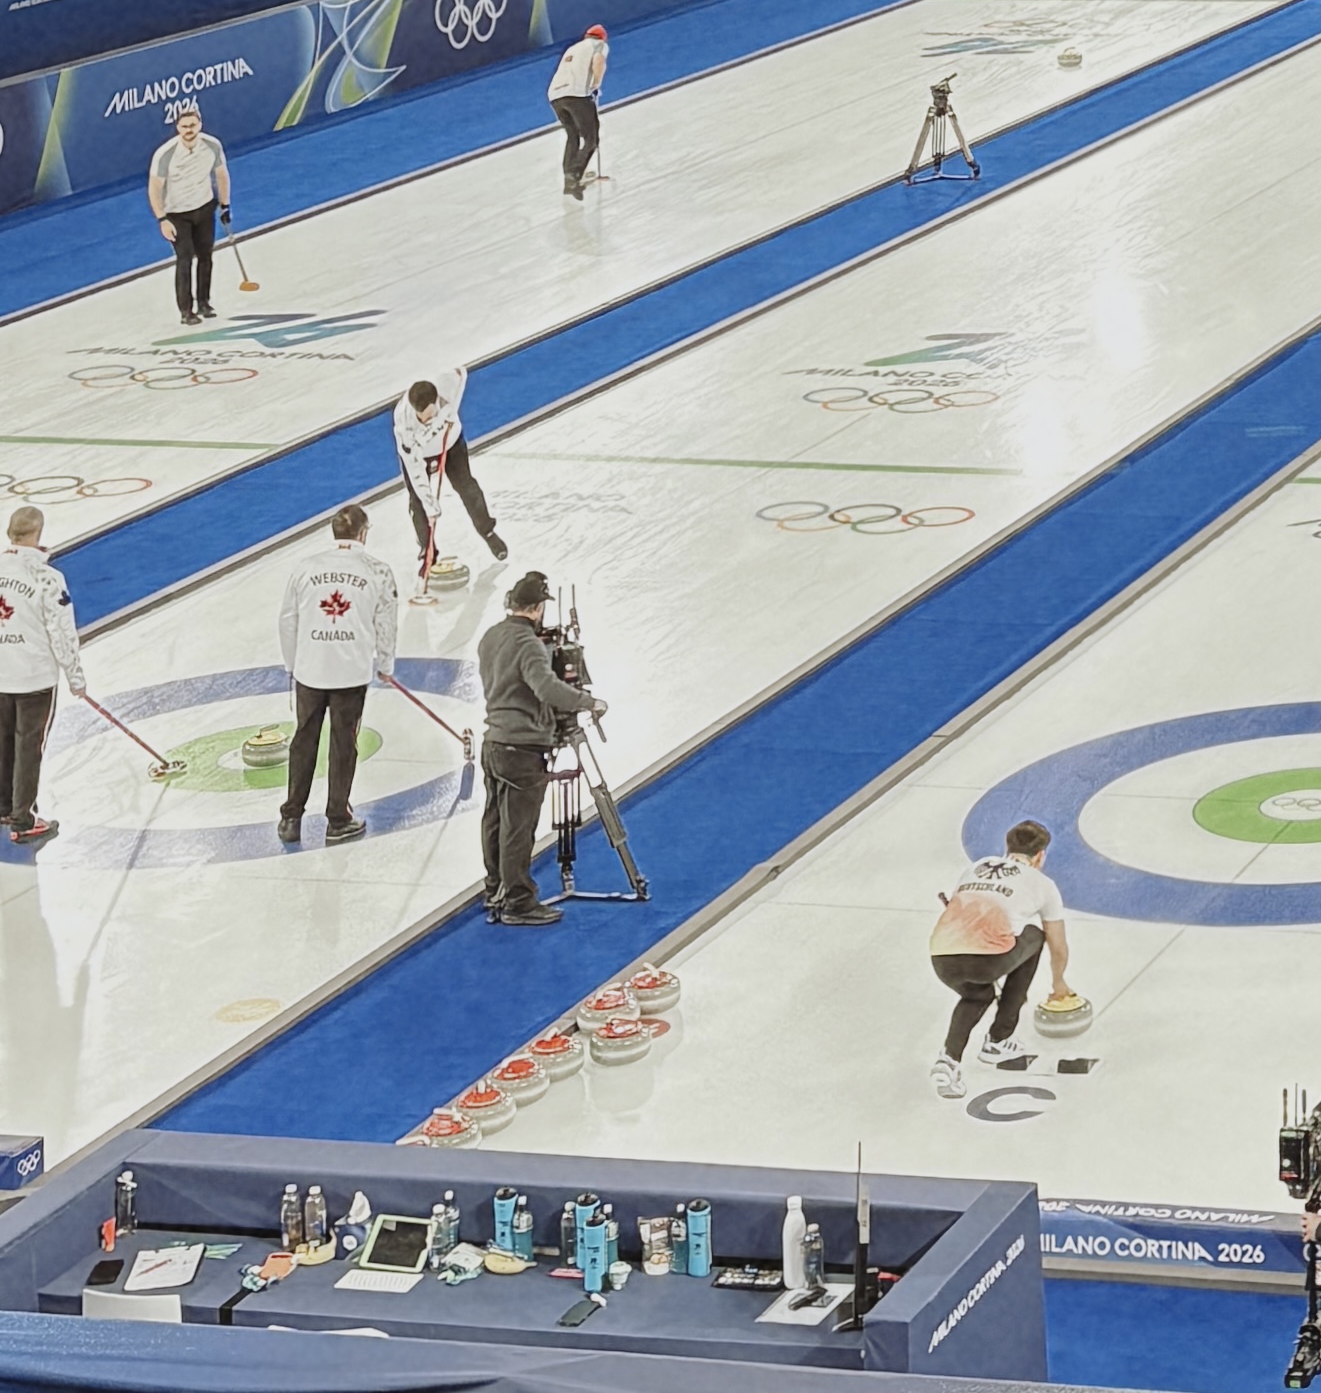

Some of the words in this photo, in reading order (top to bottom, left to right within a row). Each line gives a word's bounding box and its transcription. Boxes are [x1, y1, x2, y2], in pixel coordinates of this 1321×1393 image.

[104, 76, 180, 118] MILANO
[180, 57, 254, 95] CORTINA
[66, 345, 209, 358] MILANO
[208, 349, 356, 362] CORTINA
[781, 367, 933, 380] MILANO
[309, 571, 368, 591] WEBSTER
[310, 628, 356, 642] CANADA
[965, 1085, 1057, 1123] C
[1074, 1201, 1172, 1220] CORTINA
[1174, 1206, 1276, 1225] MILANO
[1113, 1236, 1216, 1262] CORTINA
[1217, 1243, 1266, 1264] 2026
[927, 1296, 970, 1355] MILANO
[966, 1259, 1007, 1308] CORTINA
